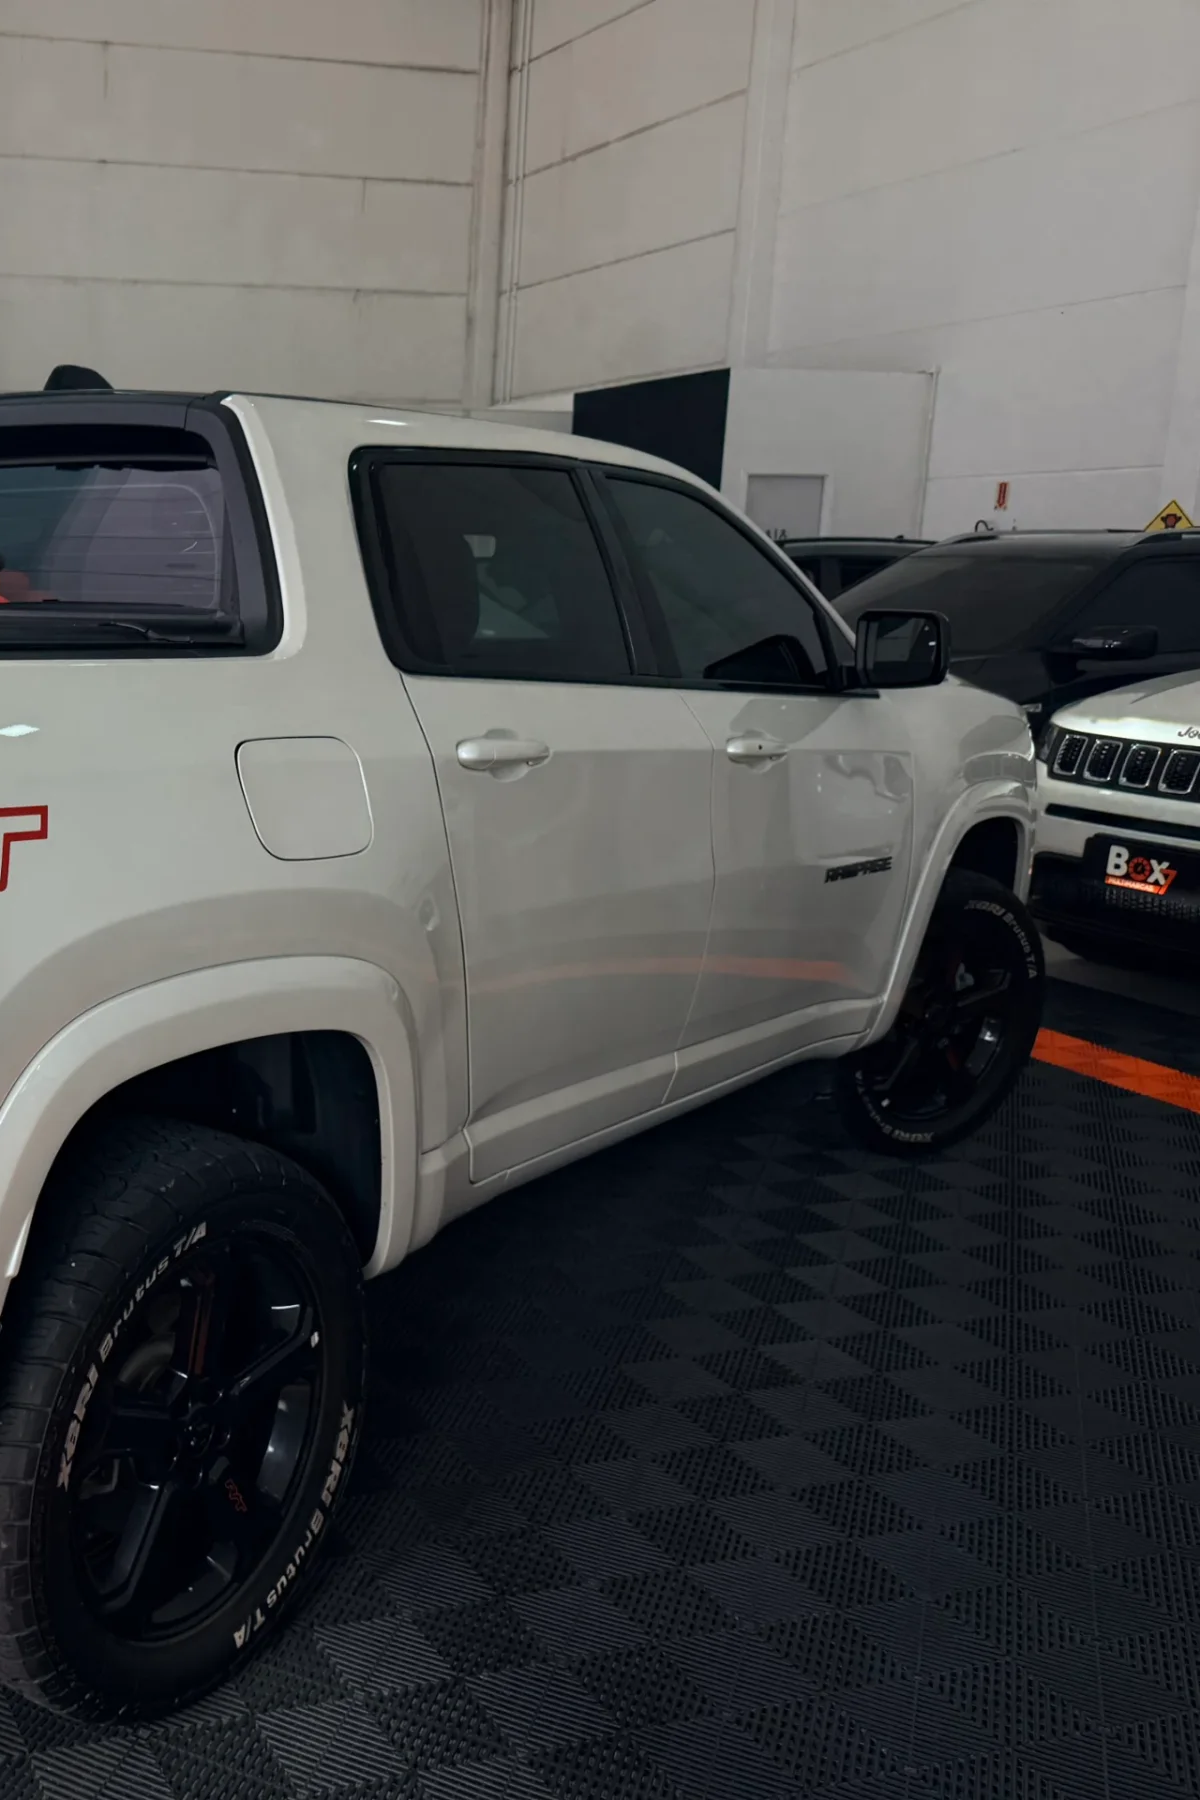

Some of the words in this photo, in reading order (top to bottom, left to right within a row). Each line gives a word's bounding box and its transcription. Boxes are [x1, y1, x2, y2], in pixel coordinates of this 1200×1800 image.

[100, 1255, 169, 1363] Brutus
[172, 1221, 207, 1259] T/A
[266, 1507, 325, 1609] Brutus
[233, 1607, 266, 1649] T/A
